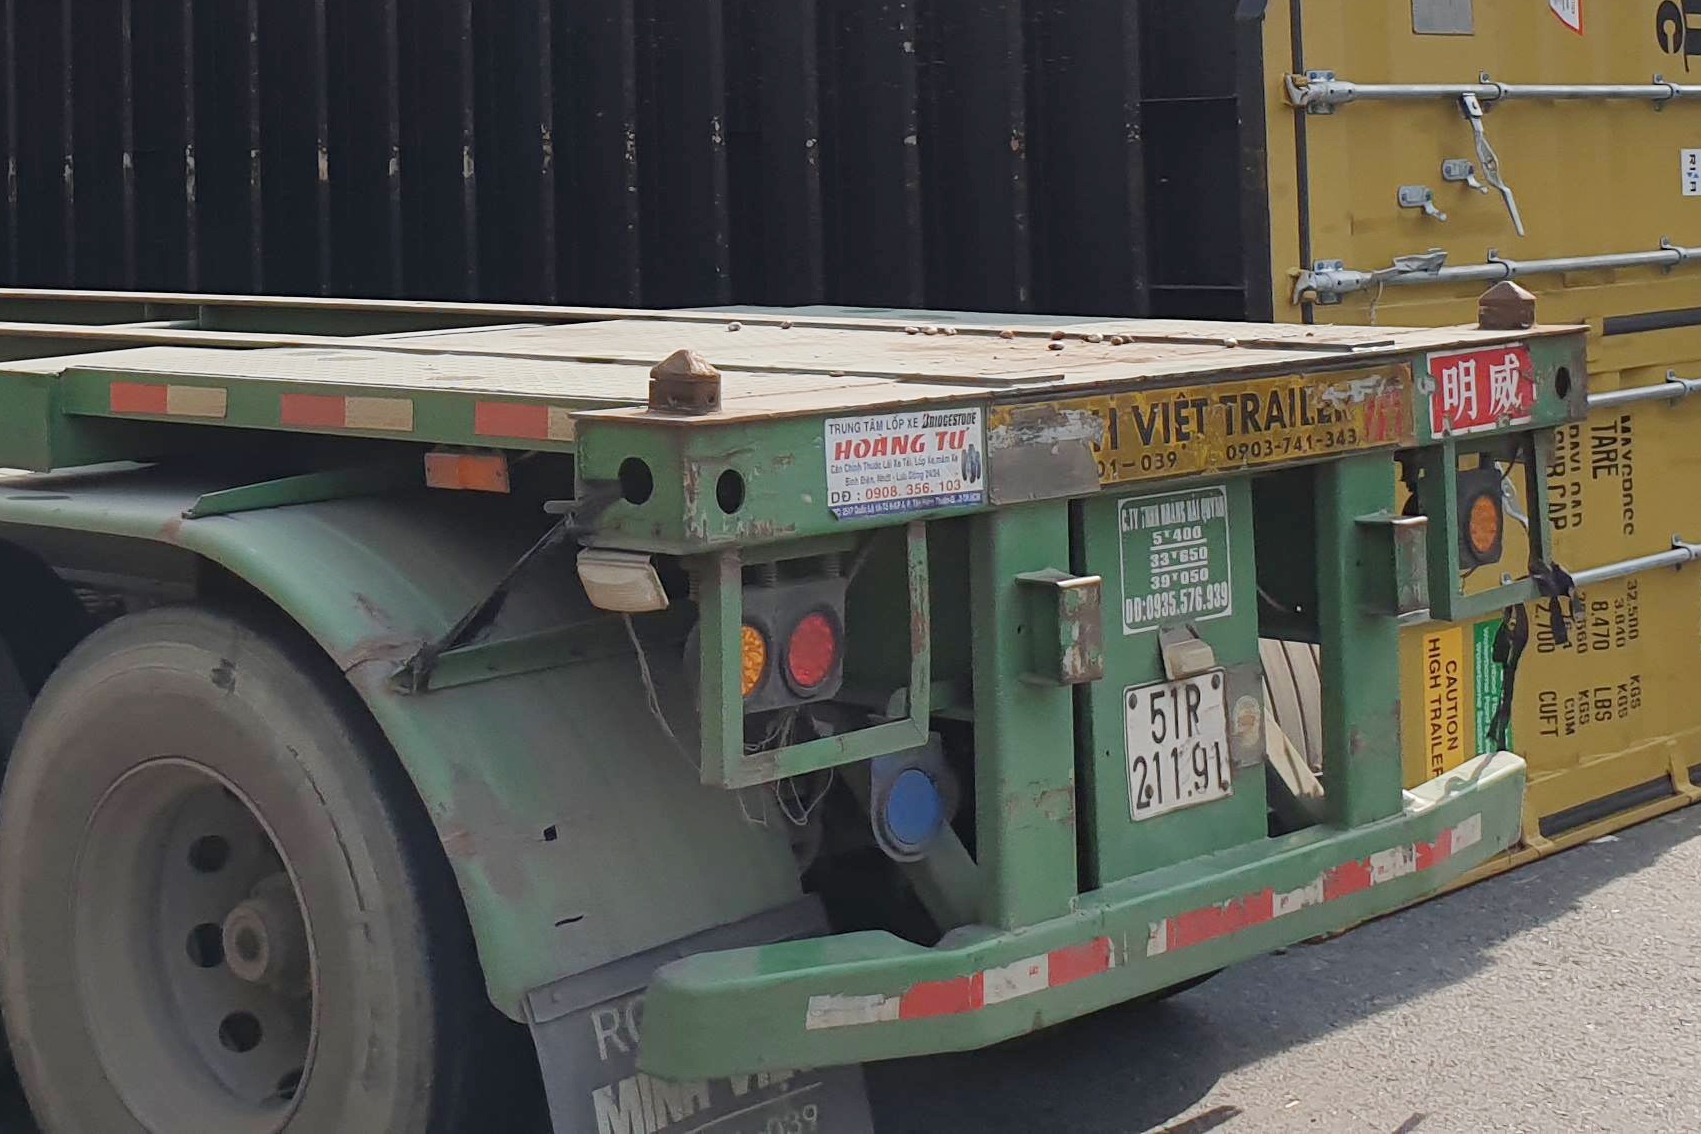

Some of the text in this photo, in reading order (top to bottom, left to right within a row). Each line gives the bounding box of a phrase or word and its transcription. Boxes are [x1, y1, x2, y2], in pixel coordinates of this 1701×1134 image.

[1442, 353, 1524, 422] 明威
[829, 421, 861, 435] TRUNG
[864, 418, 883, 432] TÂM
[907, 417, 919, 428] XE
[834, 433, 926, 461] HOÀNG
[1131, 391, 1209, 451] VIỆT
[1591, 419, 1619, 480] TARE
[939, 479, 962, 492] 103
[1428, 637, 1441, 689] HIGH
[1591, 600, 1612, 723] 8.470 LBS
[1150, 683, 1202, 745] 51R
[1445, 660, 1459, 751] CAUTION
[1563, 697, 1575, 736] CUM
[1578, 689, 1590, 726] KGS
[1132, 741, 1228, 810] 211.91
